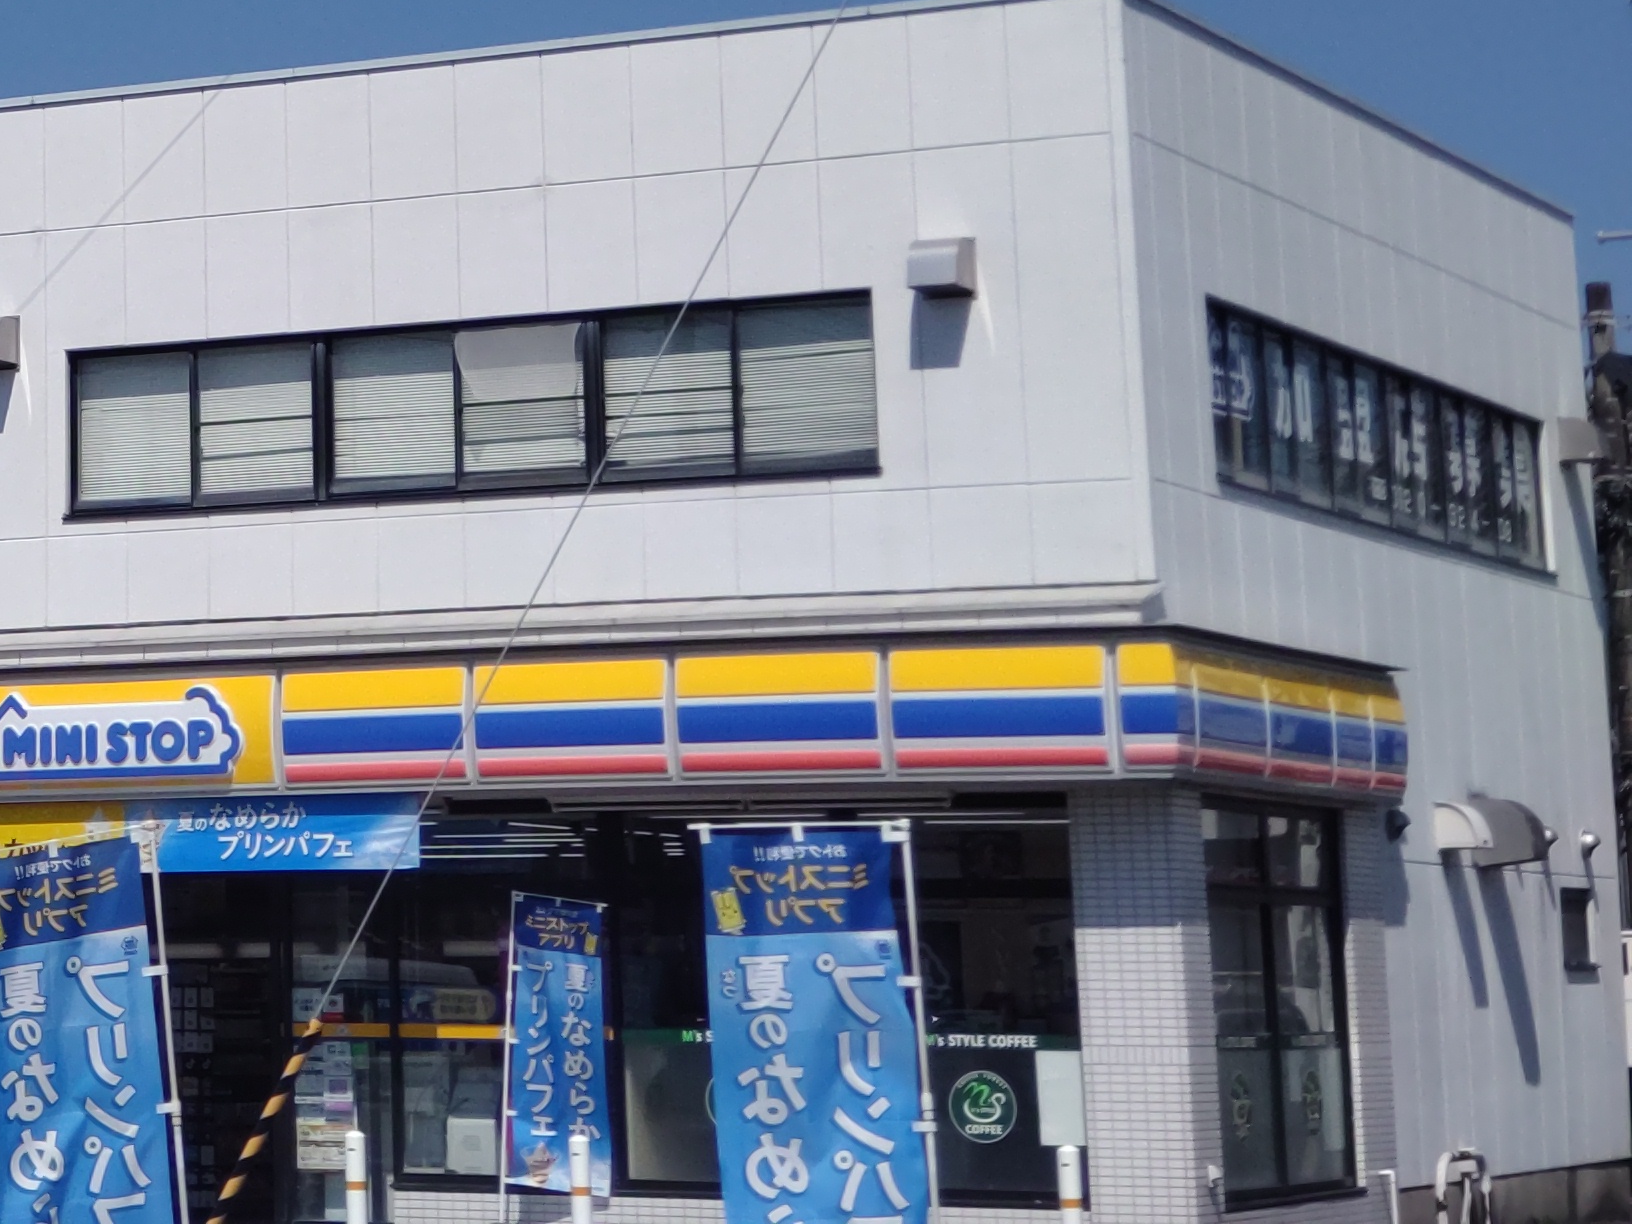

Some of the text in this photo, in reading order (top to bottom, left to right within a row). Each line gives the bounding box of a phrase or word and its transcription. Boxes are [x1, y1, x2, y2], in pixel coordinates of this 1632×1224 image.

[2, 718, 216, 766] MINI STOP
[177, 802, 306, 833] 夏のなめらか
[218, 830, 354, 860] プリンパフェ
[525, 915, 589, 935] ミニストップ
[523, 960, 558, 1136] プリンパフェ
[948, 1034, 985, 1047] STYLE
[988, 1035, 1038, 1048] COFFEE
[965, 1124, 1004, 1135] COFFEE
